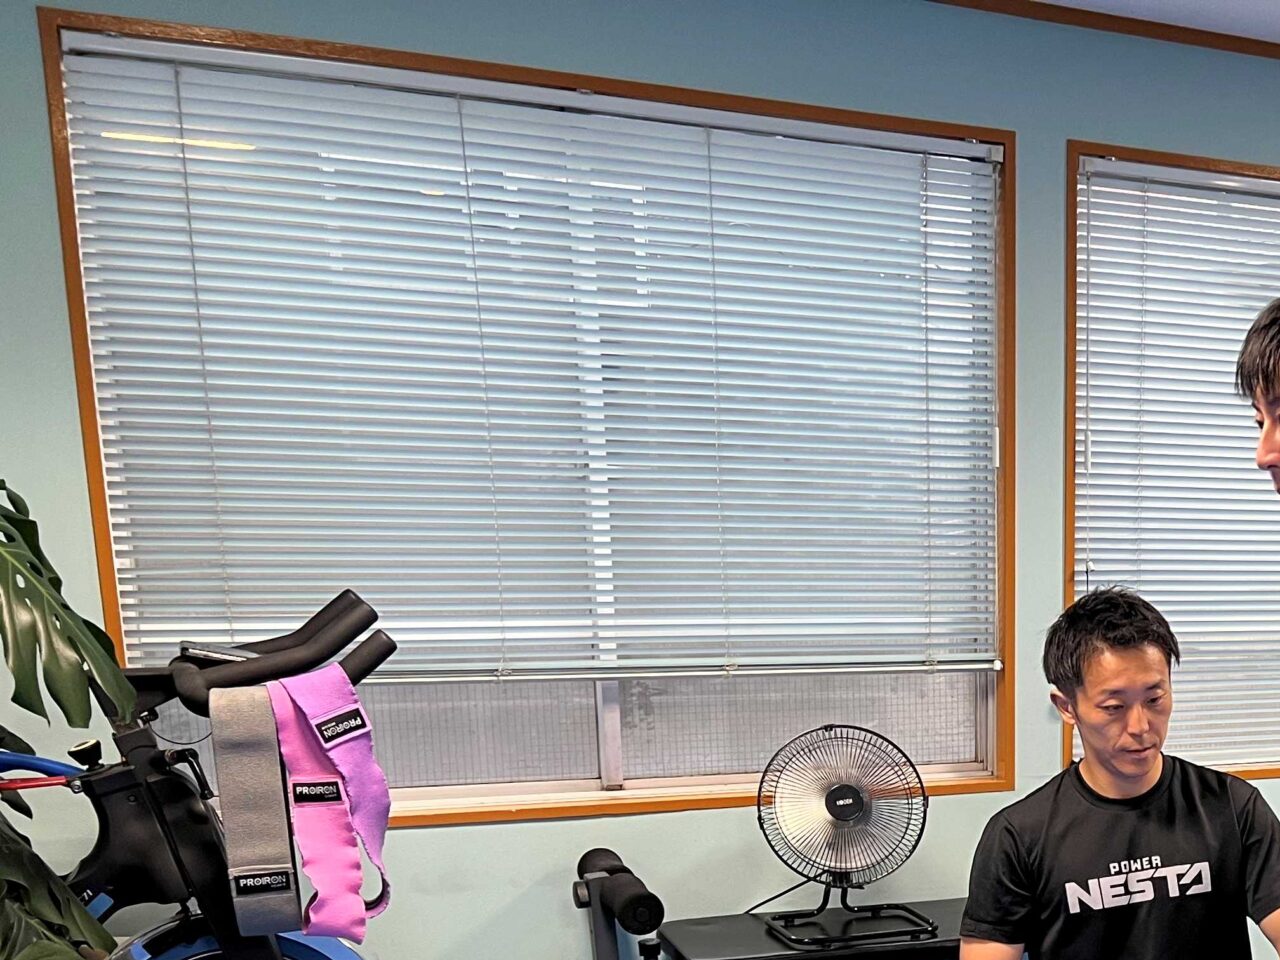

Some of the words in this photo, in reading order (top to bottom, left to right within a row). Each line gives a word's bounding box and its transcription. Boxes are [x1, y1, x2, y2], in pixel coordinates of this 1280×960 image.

[323, 717, 362, 739] PROIRON
[295, 785, 337, 795] PROIRON
[1109, 855, 1162, 875] POWER
[239, 875, 286, 887] PROIRON
[1065, 861, 1212, 914] NESTA
